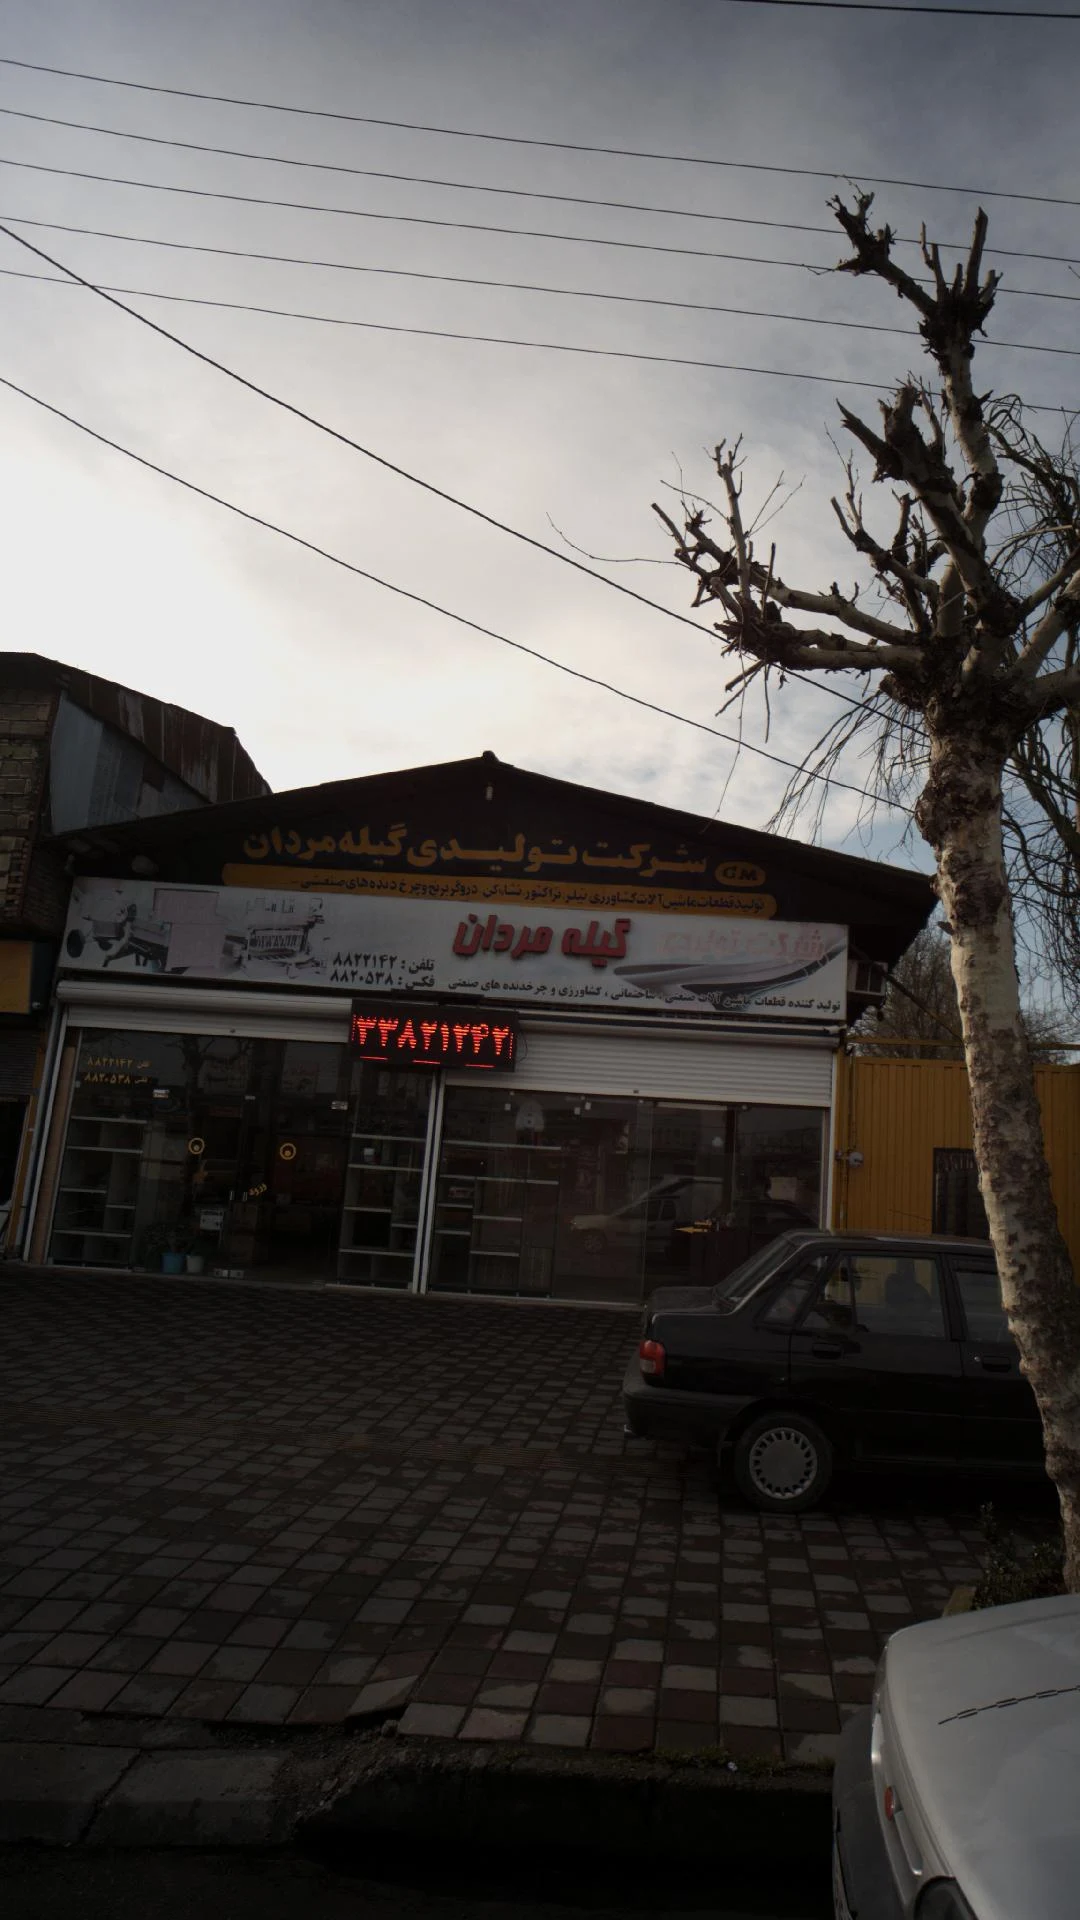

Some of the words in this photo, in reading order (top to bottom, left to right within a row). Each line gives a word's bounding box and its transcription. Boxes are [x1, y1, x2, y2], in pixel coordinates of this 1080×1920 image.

[243, 825, 337, 860] مردان
[339, 823, 408, 867] گیله
[406, 832, 578, 873] تولیدی
[581, 839, 707, 878] شرکت
[452, 914, 554, 960] مردان
[561, 918, 631, 968] گیله
[330, 969, 394, 986] ۸۸۲۰۵۳۸
[405, 974, 435, 990] فکس
[448, 979, 480, 990] صنعتی
[480, 979, 501, 991] های
[558, 984, 602, 998] کشاورزی
[755, 994, 786, 1007] قطعات
[788, 999, 815, 1008] کننده
[817, 1000, 841, 1014] تولید
[356, 1015, 511, 1057] ۳۳۸۲۱۲۴۲
